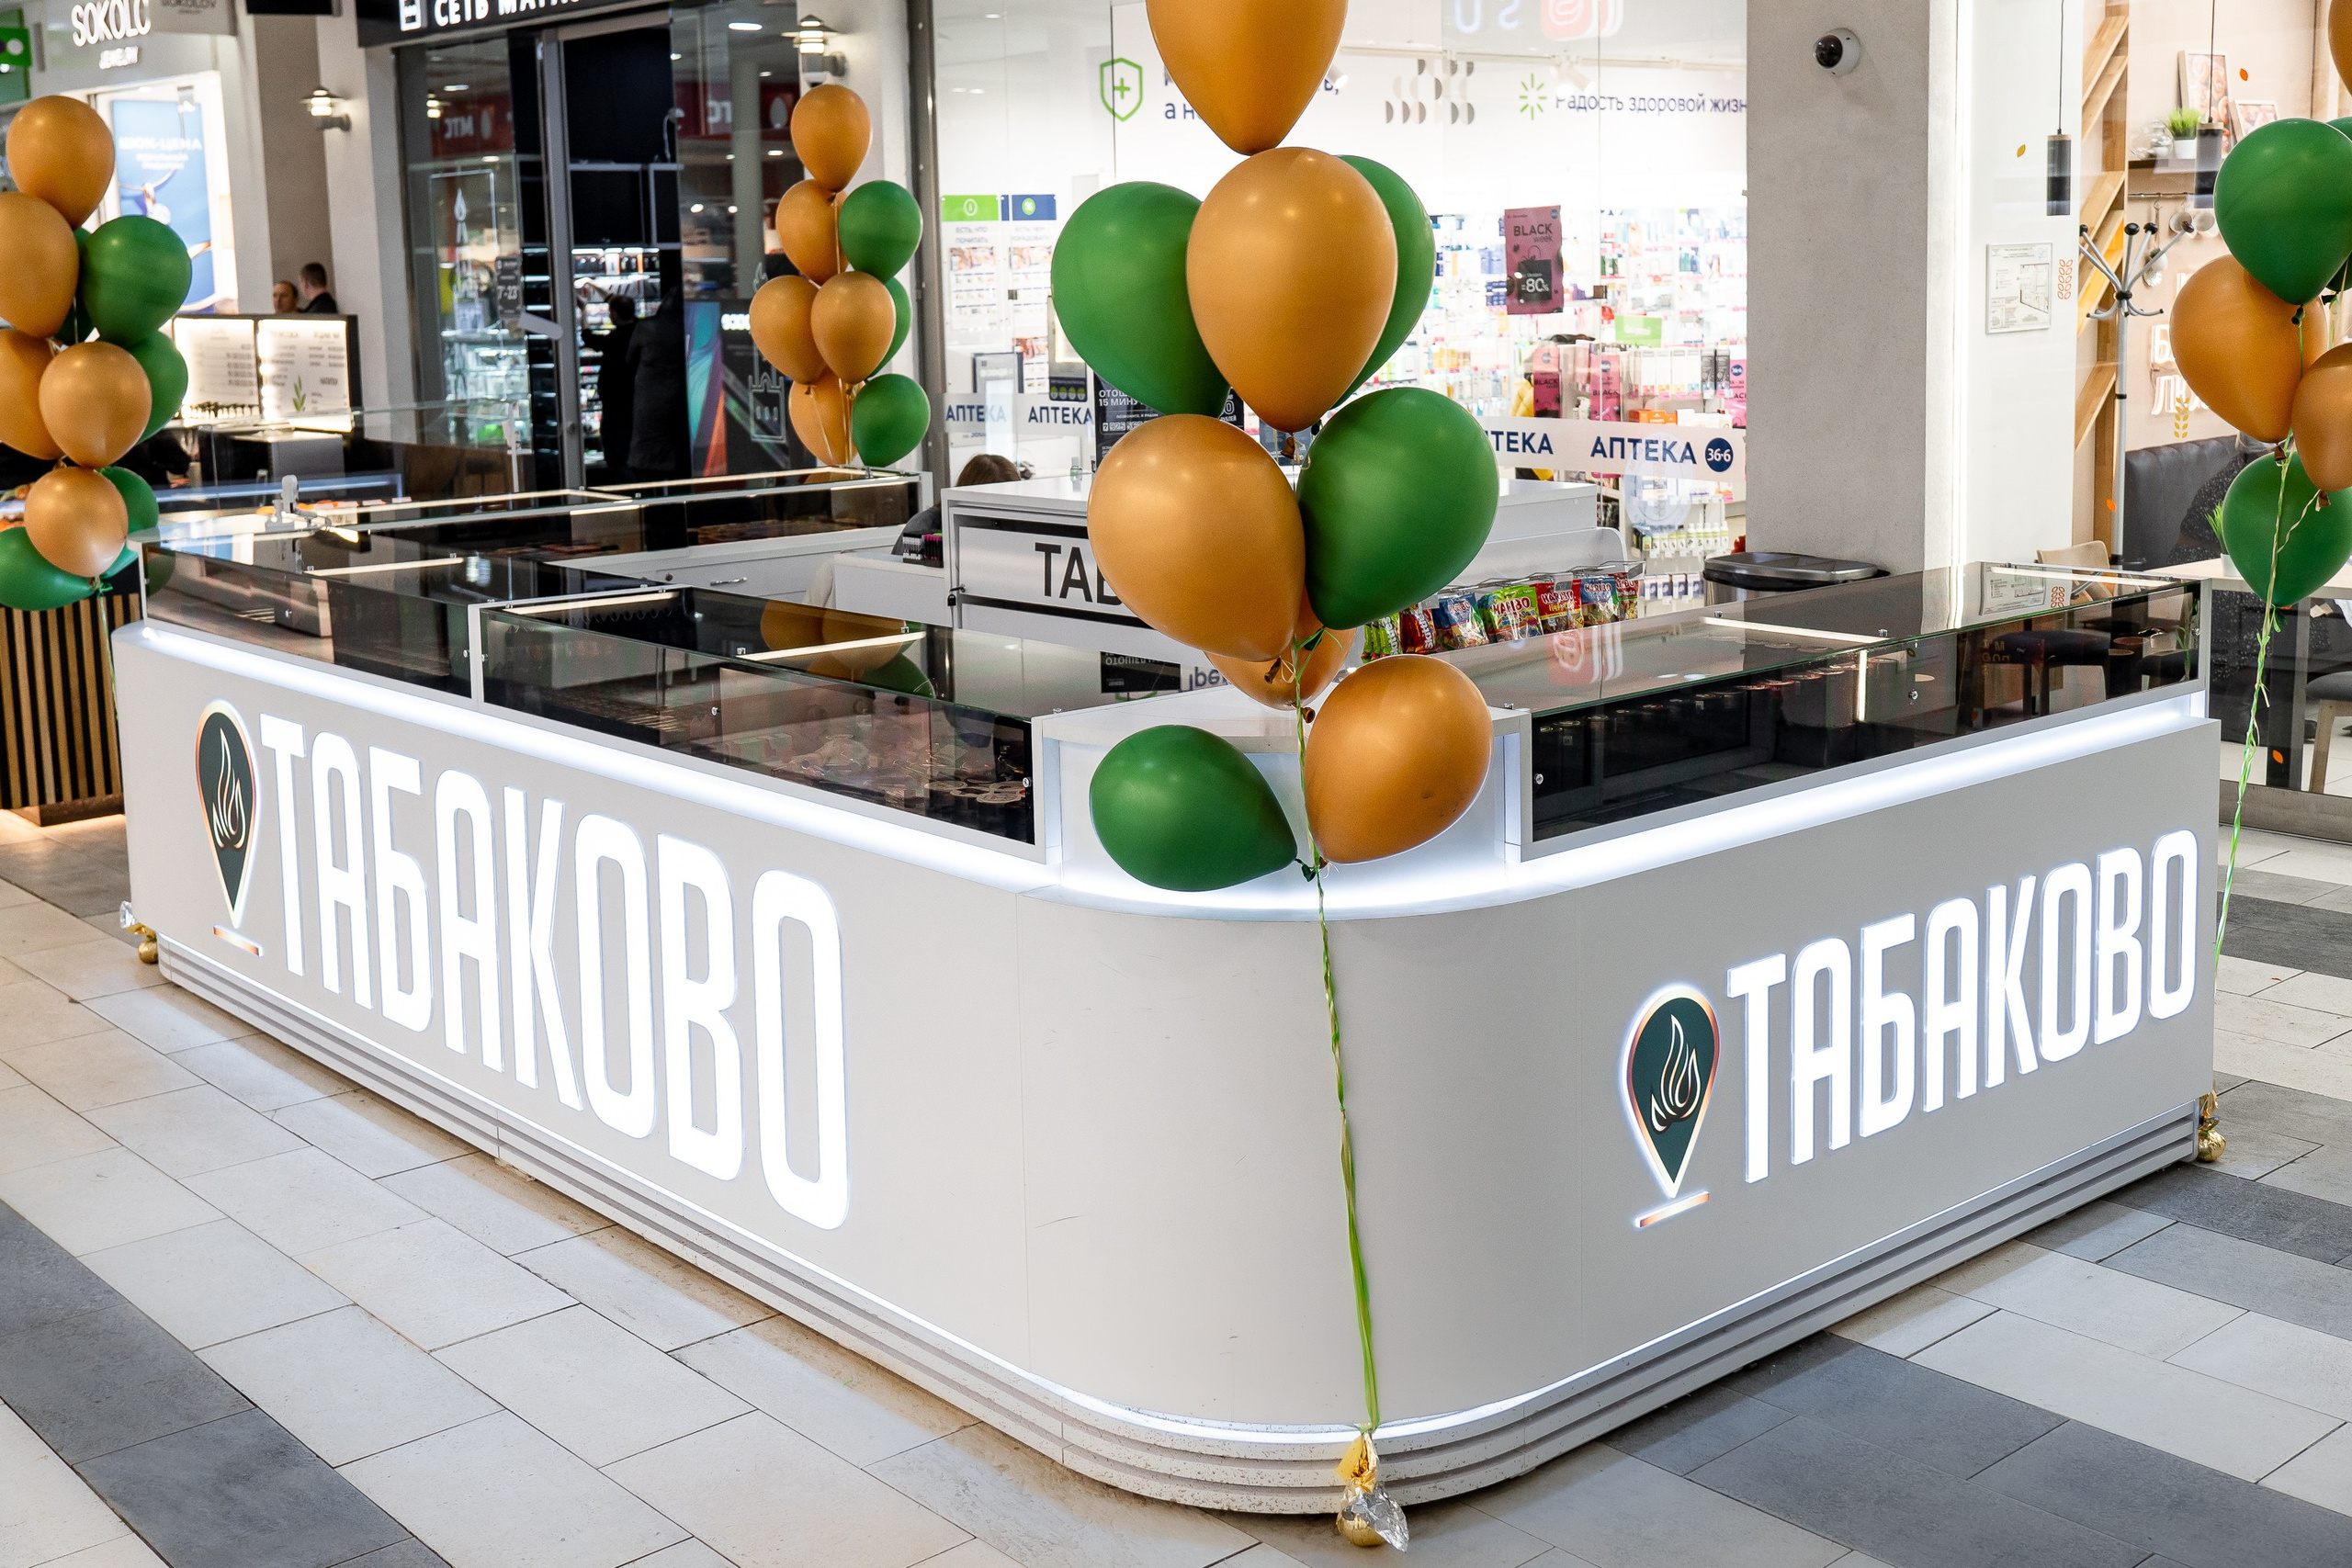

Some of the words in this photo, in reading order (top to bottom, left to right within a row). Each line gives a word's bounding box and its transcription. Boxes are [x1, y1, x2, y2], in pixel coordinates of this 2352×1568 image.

[1628, 93, 1706, 116] здоровой
[1513, 222, 1553, 237] BLACK
[945, 404, 1008, 423] АПТЕКА
[1099, 399, 1109, 407] 15
[1028, 405, 1095, 425] АПТЕКА
[1485, 430, 1554, 455] ТЕКА
[1590, 436, 1698, 465] АПТЕКА
[1583, 581, 1613, 593] HARIBO
[259, 713, 851, 1231] ТАБАКОВО
[1726, 829, 2199, 1185] ТАБАКОВО
